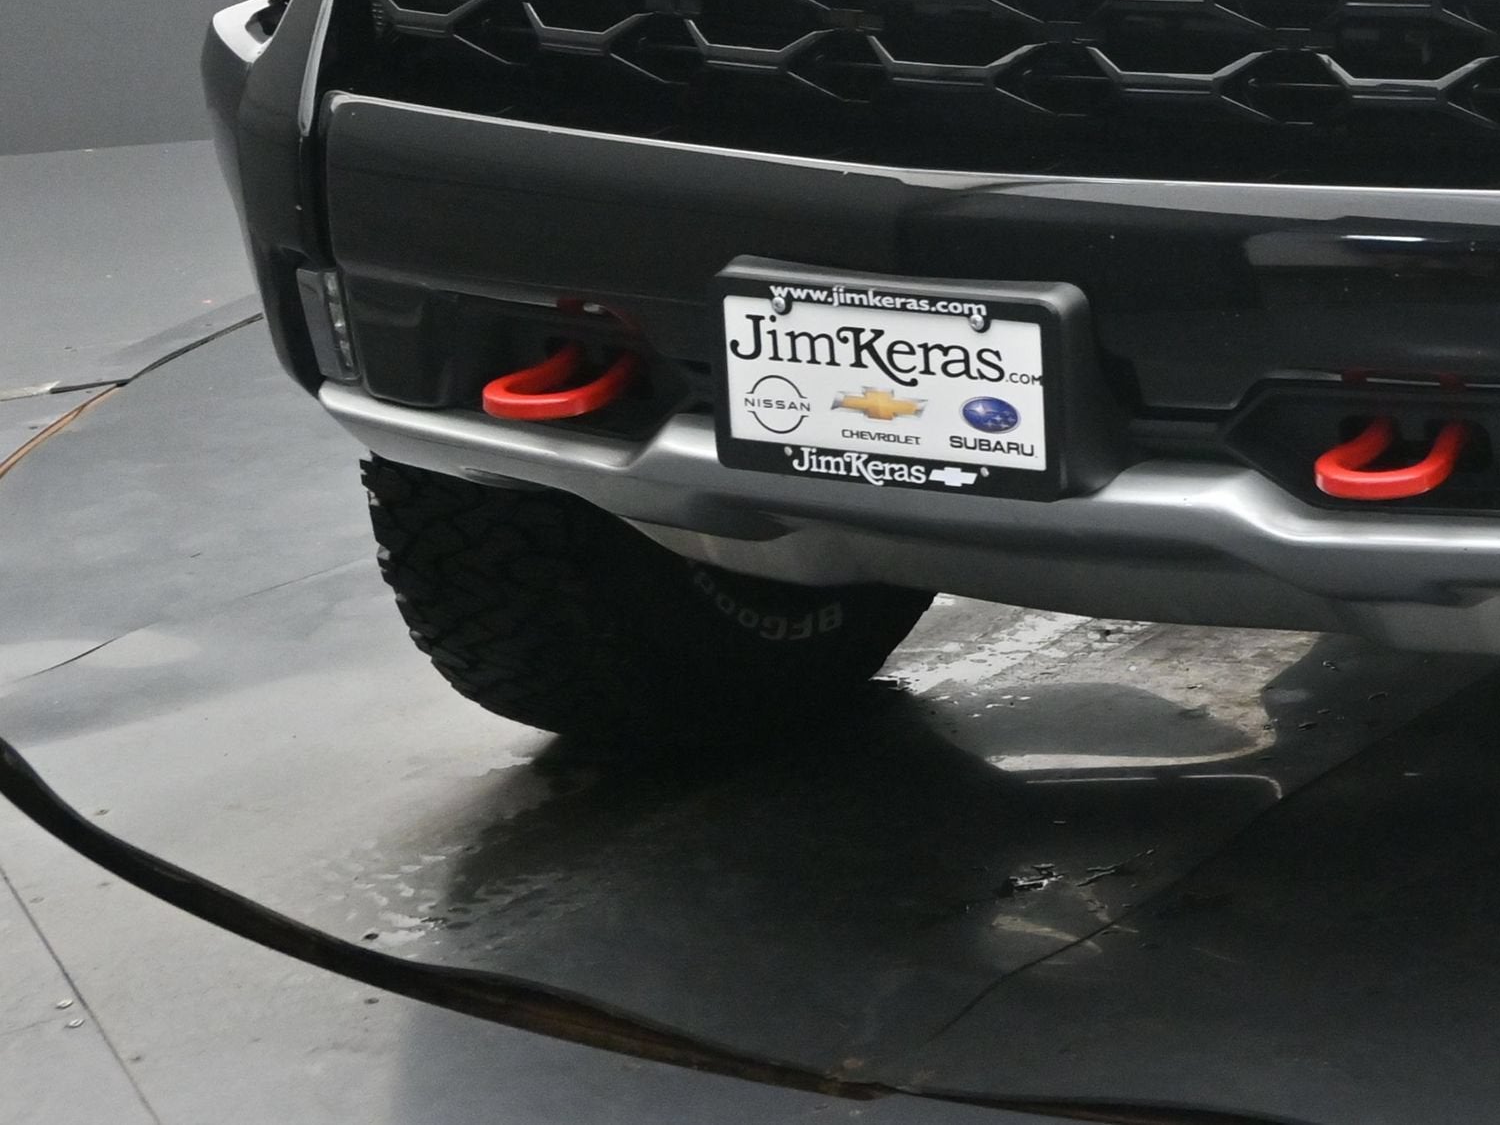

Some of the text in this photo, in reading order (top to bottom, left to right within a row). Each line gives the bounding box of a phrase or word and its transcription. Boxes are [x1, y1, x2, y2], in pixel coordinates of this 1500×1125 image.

[769, 284, 987, 316] www.jimkeras.com
[744, 396, 811, 412] NISSAN
[841, 428, 921, 446] CHEVROLET
[949, 435, 1035, 457] SUBARU
